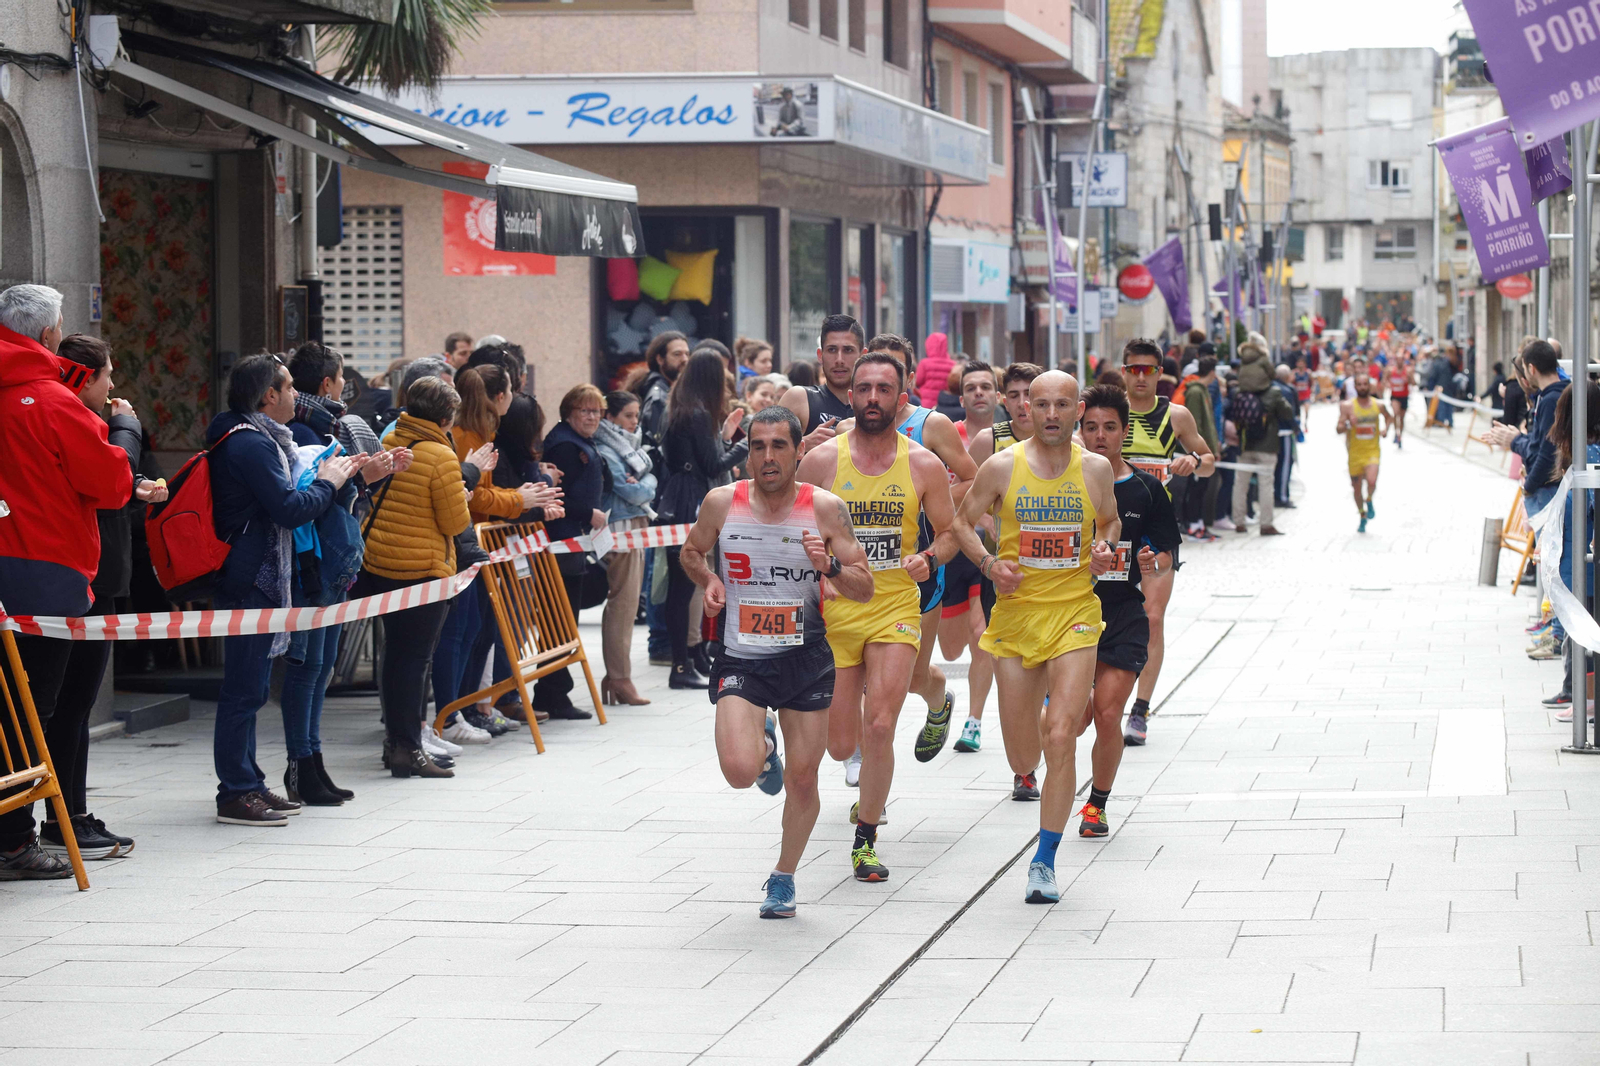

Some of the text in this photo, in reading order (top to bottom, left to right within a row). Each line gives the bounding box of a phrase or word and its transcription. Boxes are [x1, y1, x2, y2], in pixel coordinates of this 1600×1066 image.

[1549, 89, 1571, 110] DO
[1570, 80, 1585, 101] 8
[566, 91, 739, 139] Regalos
[1485, 232, 1494, 242] AS
[1487, 231, 1534, 258] PORRIÑO
[846, 500, 905, 514] THLETICS
[1015, 495, 1083, 509] ATHLETICS
[863, 512, 903, 526] LÁZARO
[1016, 508, 1083, 522] SAN LÁZARO
[1031, 538, 1064, 558] 965
[751, 613, 785, 634] 249
[915, 742, 942, 753] BROOKS
